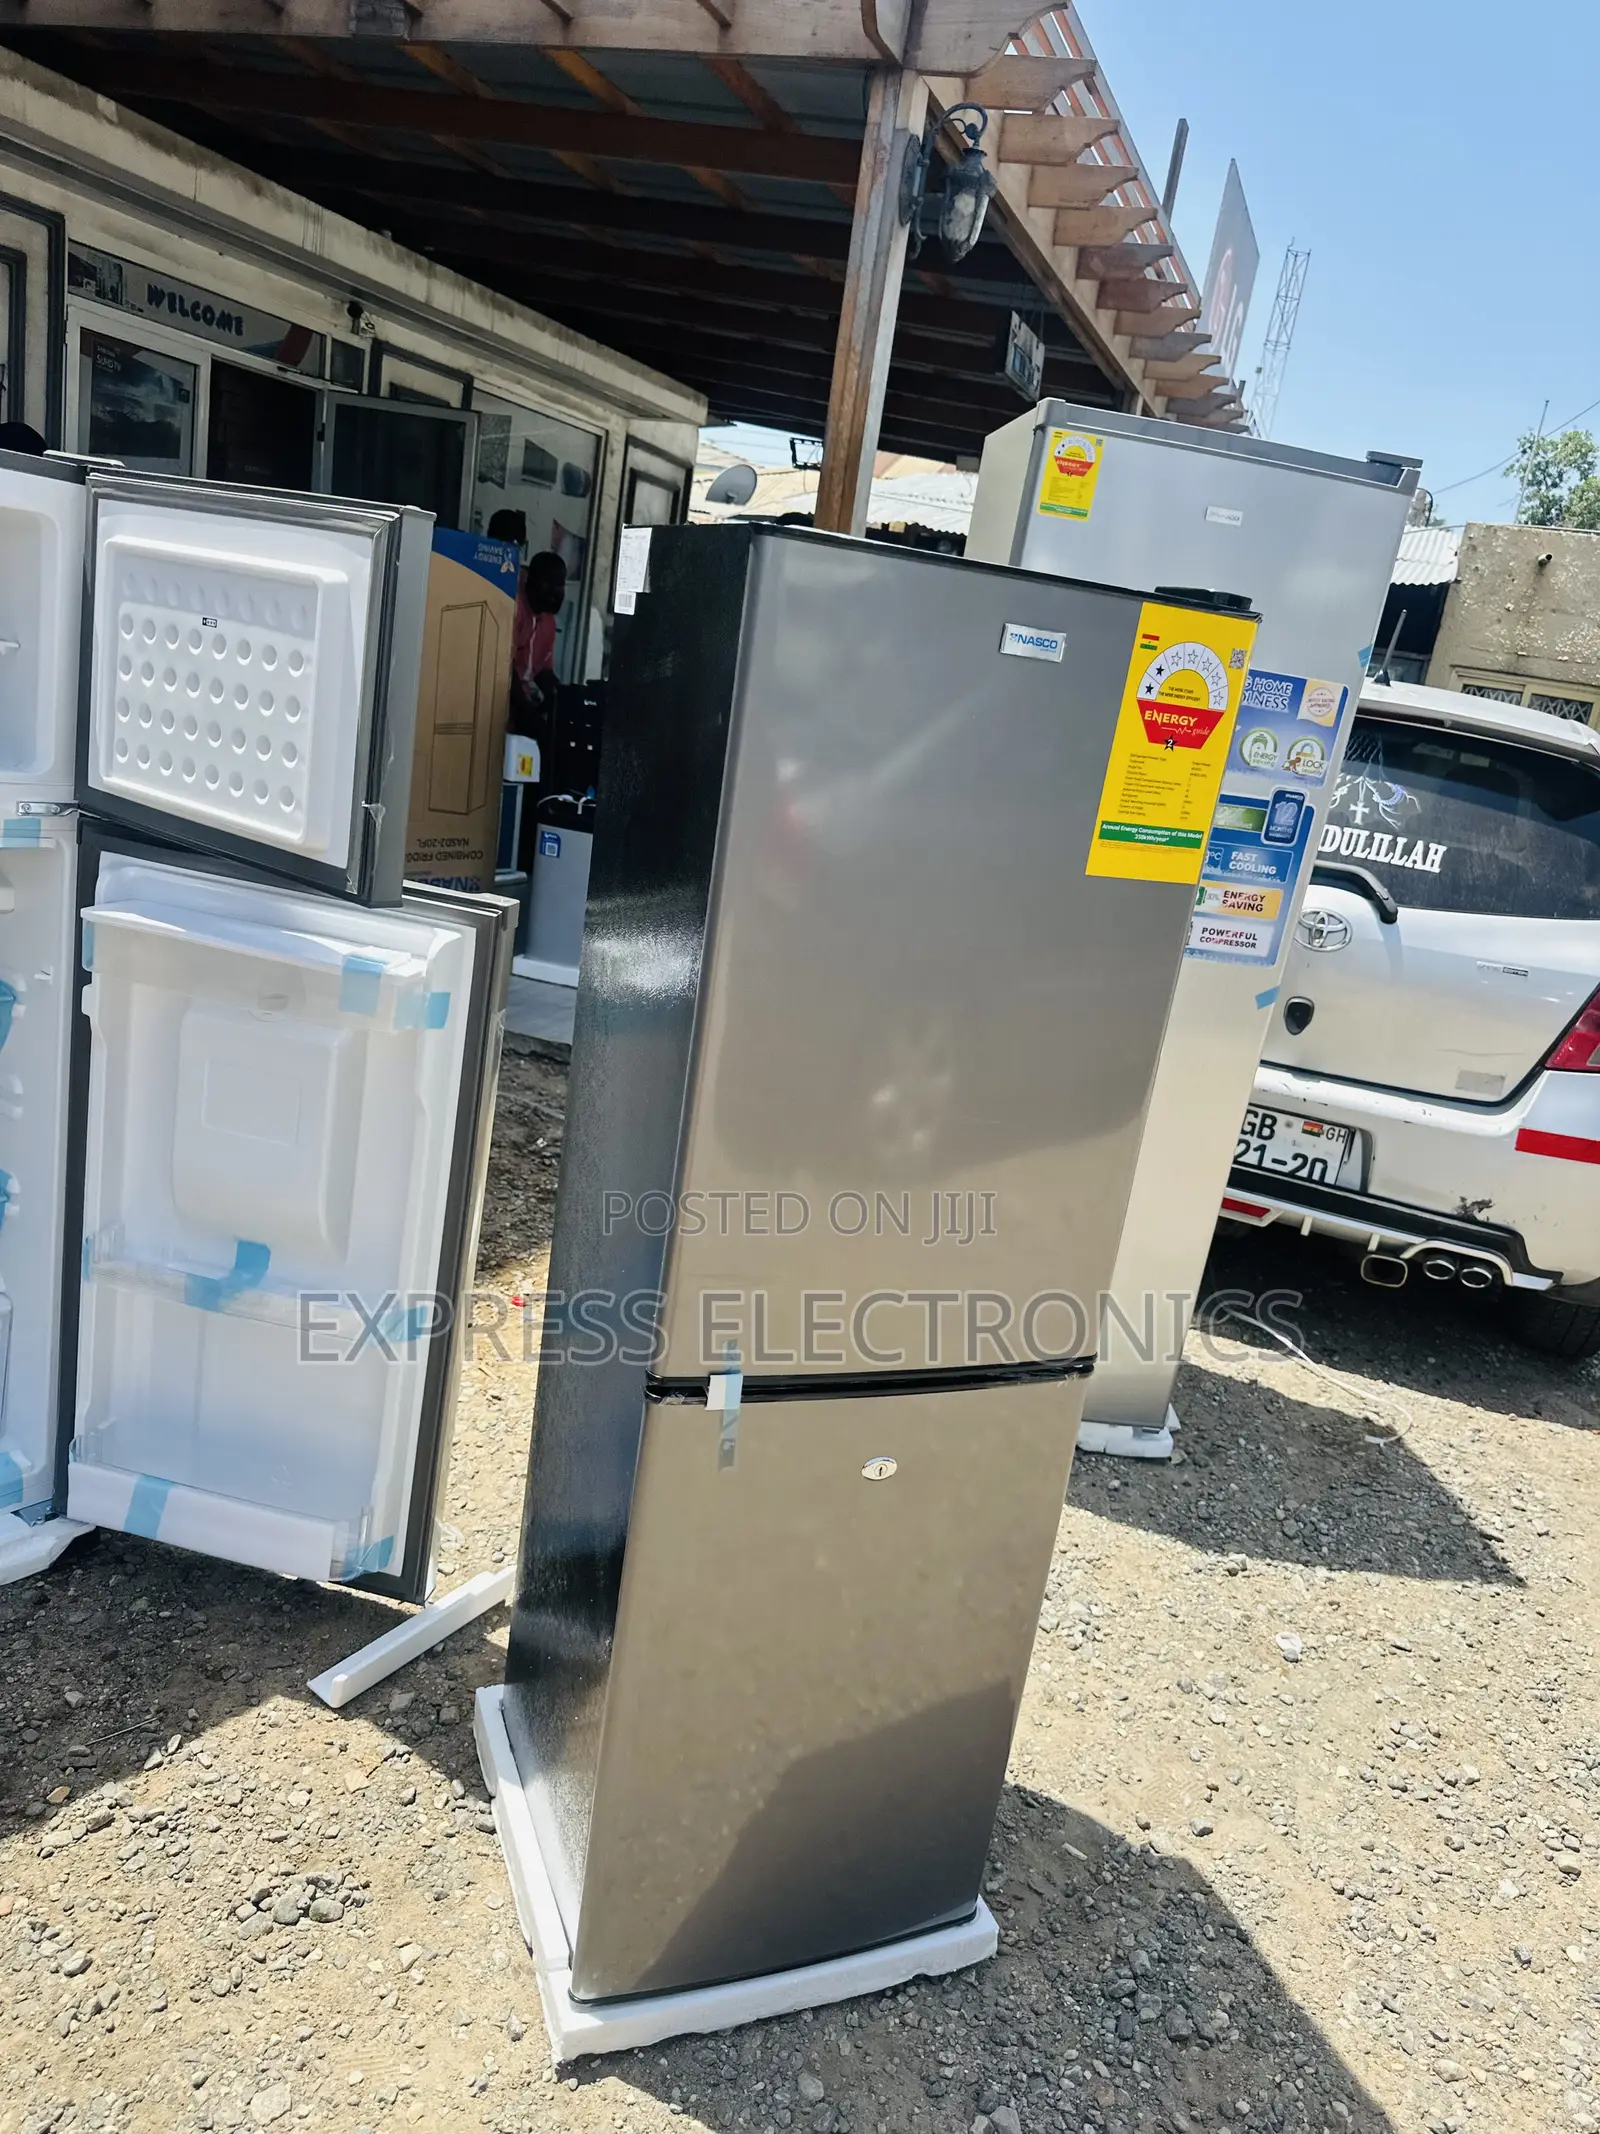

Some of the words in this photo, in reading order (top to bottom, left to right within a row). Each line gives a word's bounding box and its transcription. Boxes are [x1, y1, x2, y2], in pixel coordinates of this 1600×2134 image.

[146, 283, 244, 337] WELCOME
[1017, 633, 1058, 649] NASCO
[1253, 677, 1293, 696] HOME
[1144, 709, 1198, 727] ENERGY
[1192, 726, 1210, 737] guide
[1166, 739, 1173, 748] 2
[1252, 751, 1277, 761] ENERGY
[1303, 759, 1324, 770] LOCK
[1275, 801, 1298, 826] 12
[1102, 823, 1120, 831] Annual
[1120, 825, 1138, 834] Energy
[1138, 827, 1171, 837] Consumption
[405, 851, 434, 863] FRIDG
[435, 850, 484, 862] COMBINED
[1231, 851, 1258, 862] FAST
[1229, 861, 1277, 875] COOLING
[1223, 890, 1266, 902] ENERGY
[1222, 899, 1264, 912] SAVING
[1201, 927, 1258, 941] POWERFUL
[1240, 1108, 1278, 1141] GB
[1325, 1127, 1348, 1143] GH
